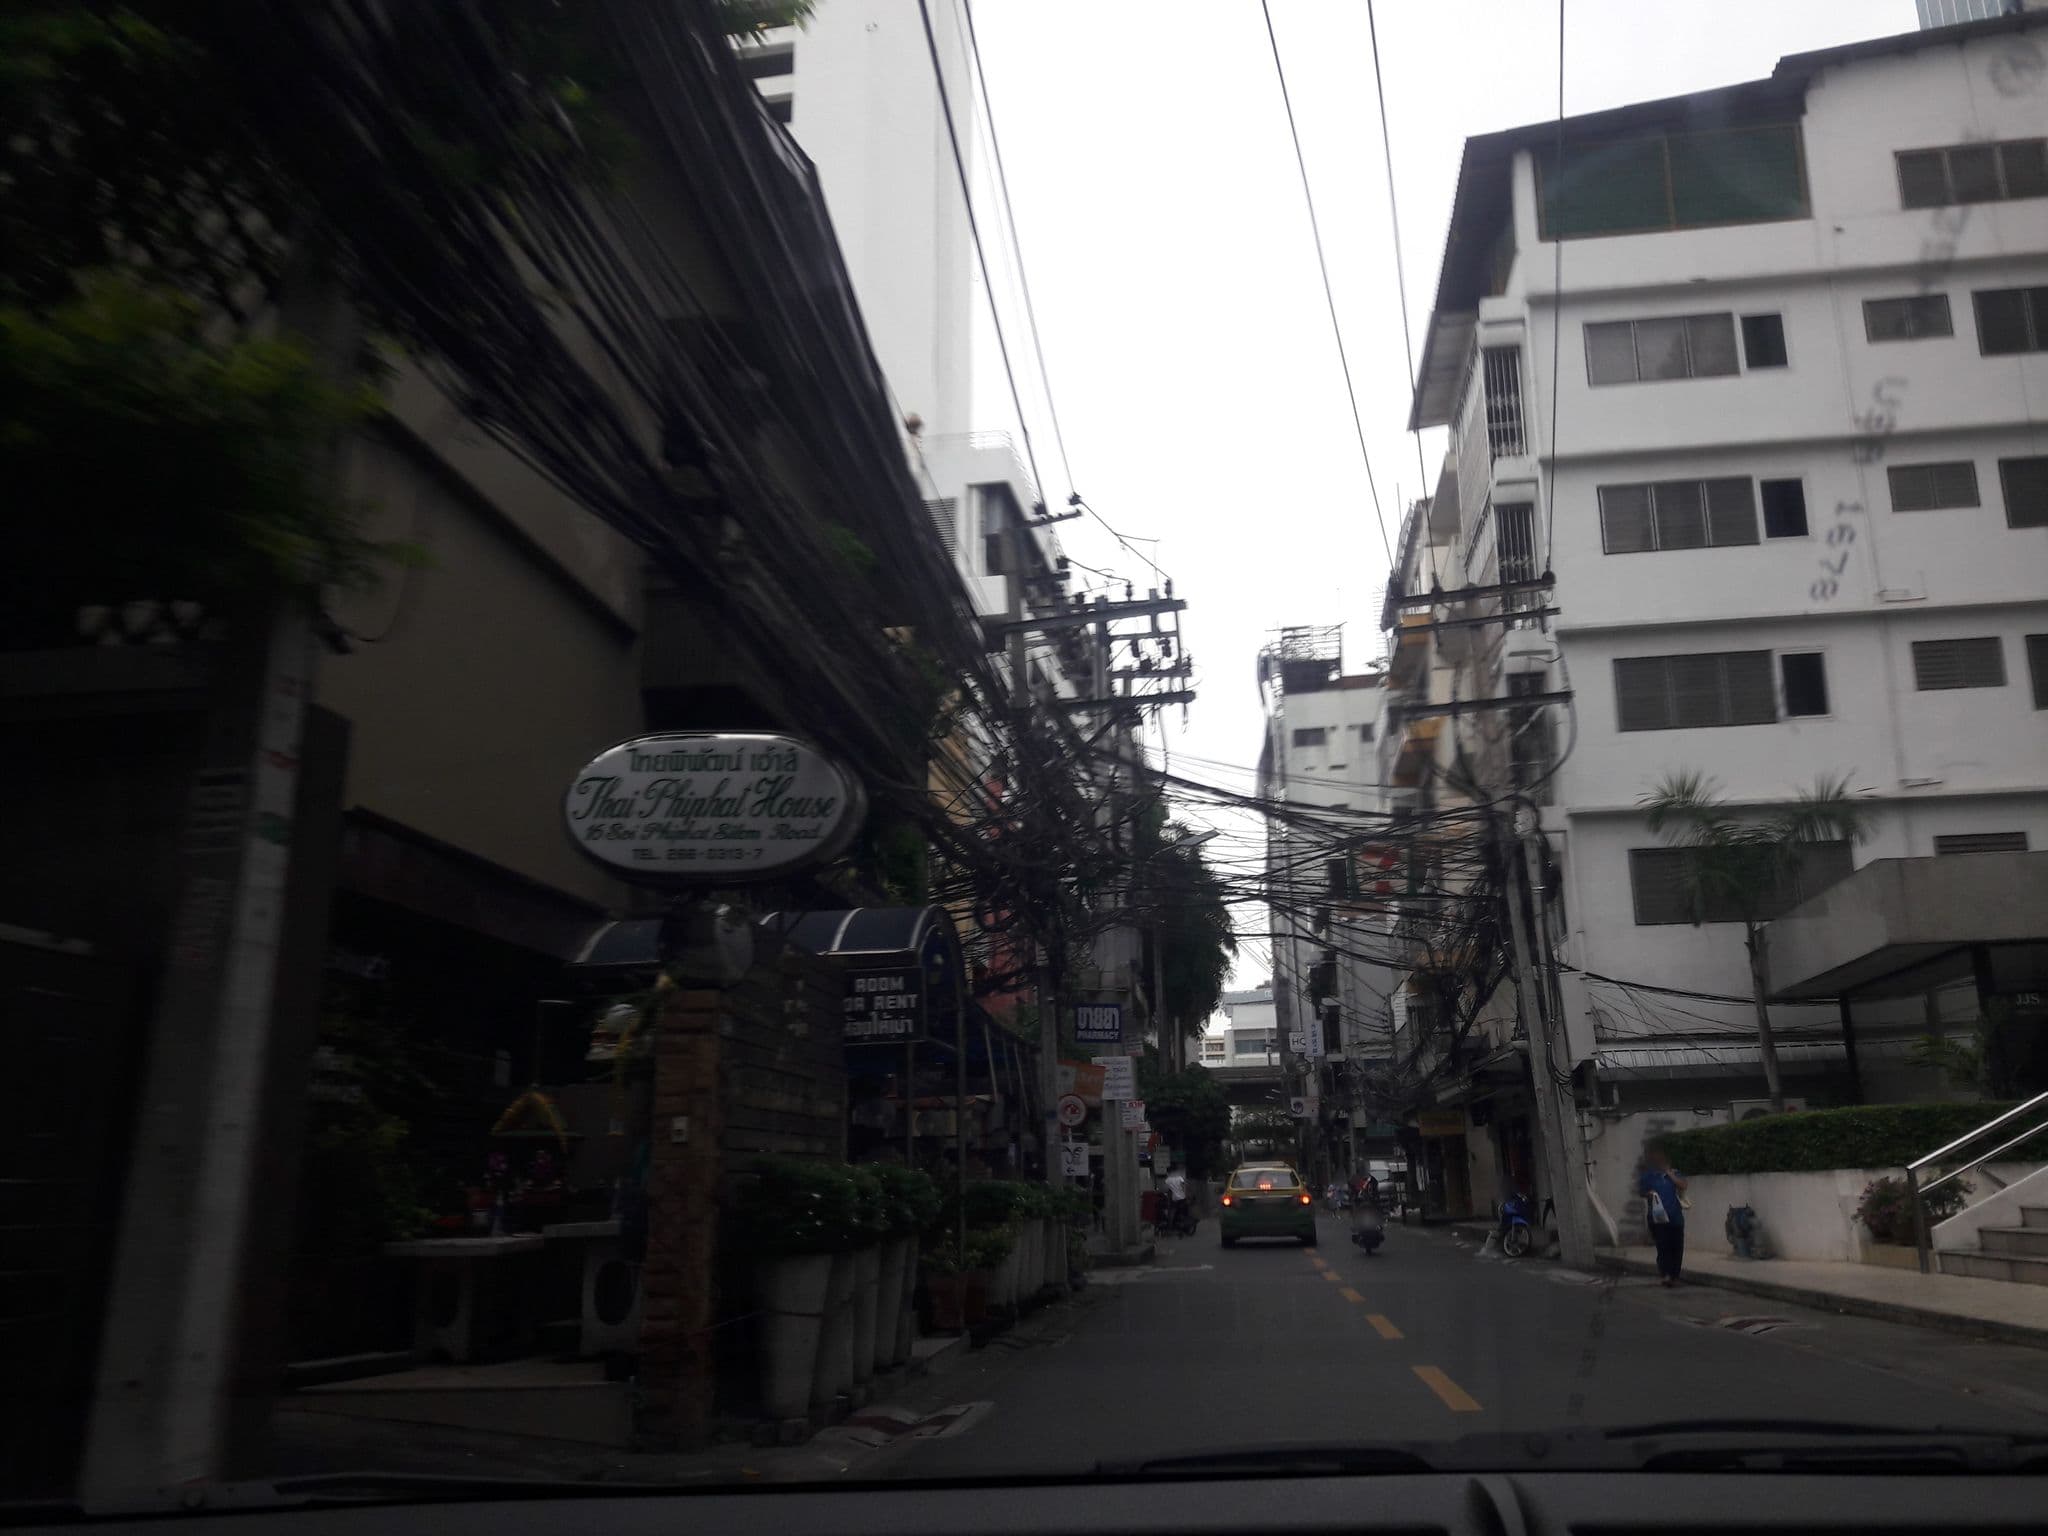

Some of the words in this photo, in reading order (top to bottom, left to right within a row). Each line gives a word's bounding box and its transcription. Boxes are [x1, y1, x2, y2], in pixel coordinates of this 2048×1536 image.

[573, 775, 640, 820] Thai
[639, 776, 752, 826] Phiphat
[750, 774, 836, 820] House
[607, 822, 639, 841] Soi
[855, 976, 905, 993] ROOM
[873, 993, 918, 1010] RENT
[1077, 1007, 1120, 1029] ขายยา
[1076, 1030, 1120, 1041] PHARMACY
